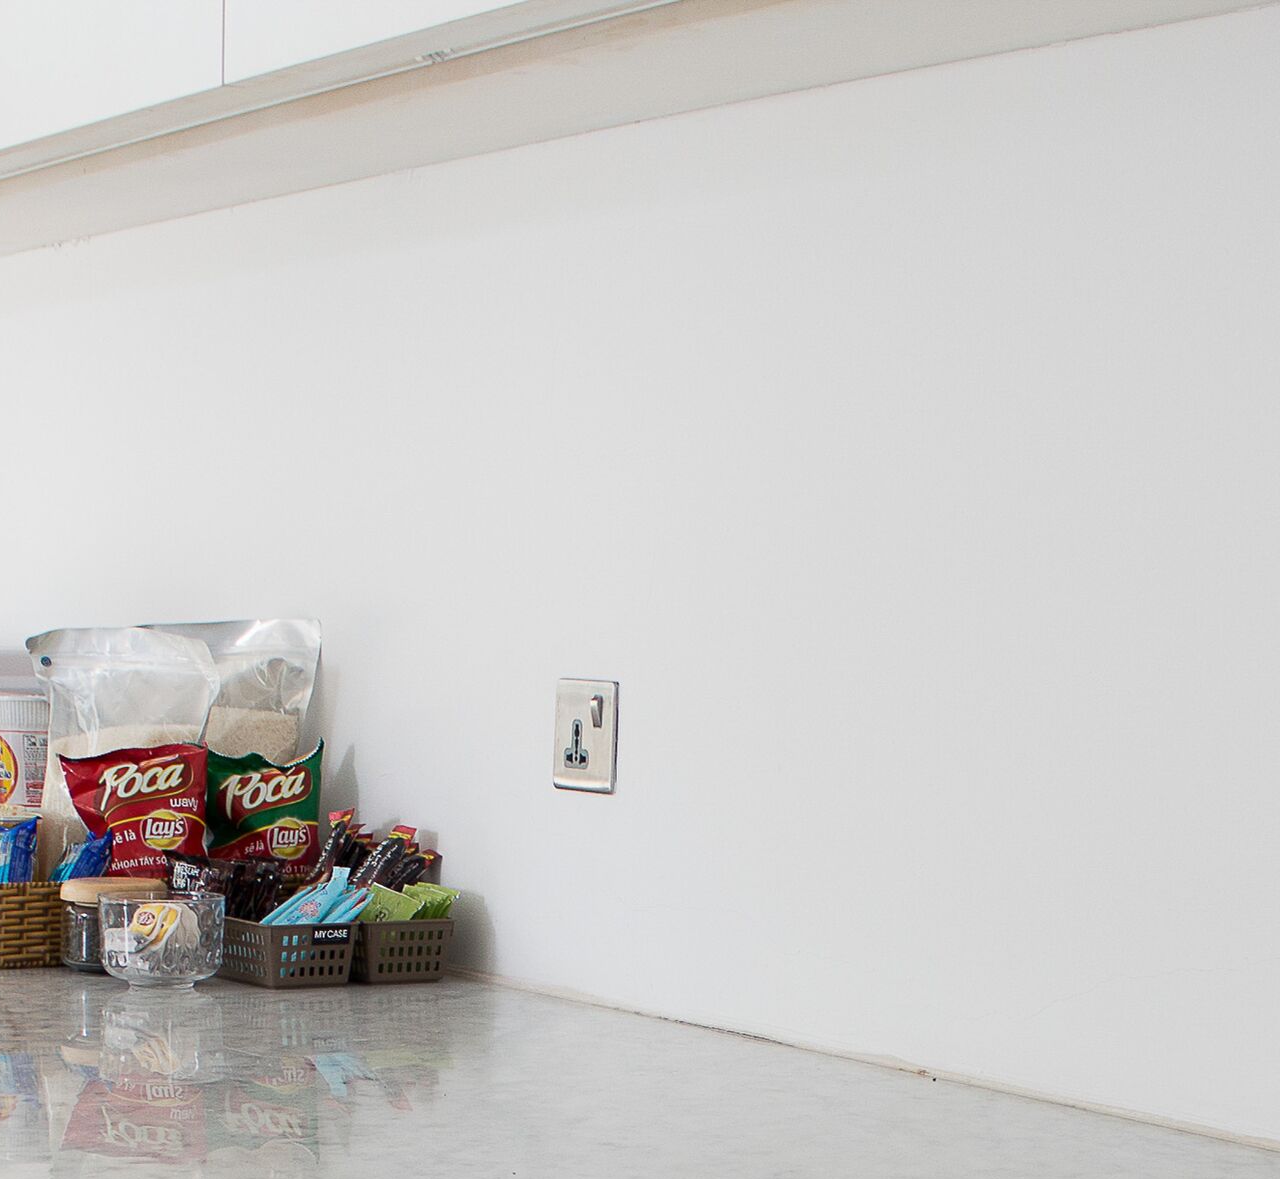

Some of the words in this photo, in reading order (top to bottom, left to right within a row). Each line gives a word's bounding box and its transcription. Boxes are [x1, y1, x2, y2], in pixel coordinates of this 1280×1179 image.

[98, 763, 185, 812] Poca
[220, 770, 306, 820] Poca
[169, 796, 199, 812] wavy
[145, 818, 185, 840] Lay's
[272, 825, 307, 849] Lay's
[111, 858, 139, 872] KHOAI
[314, 930, 327, 939] MY
[327, 929, 348, 939] CASE
